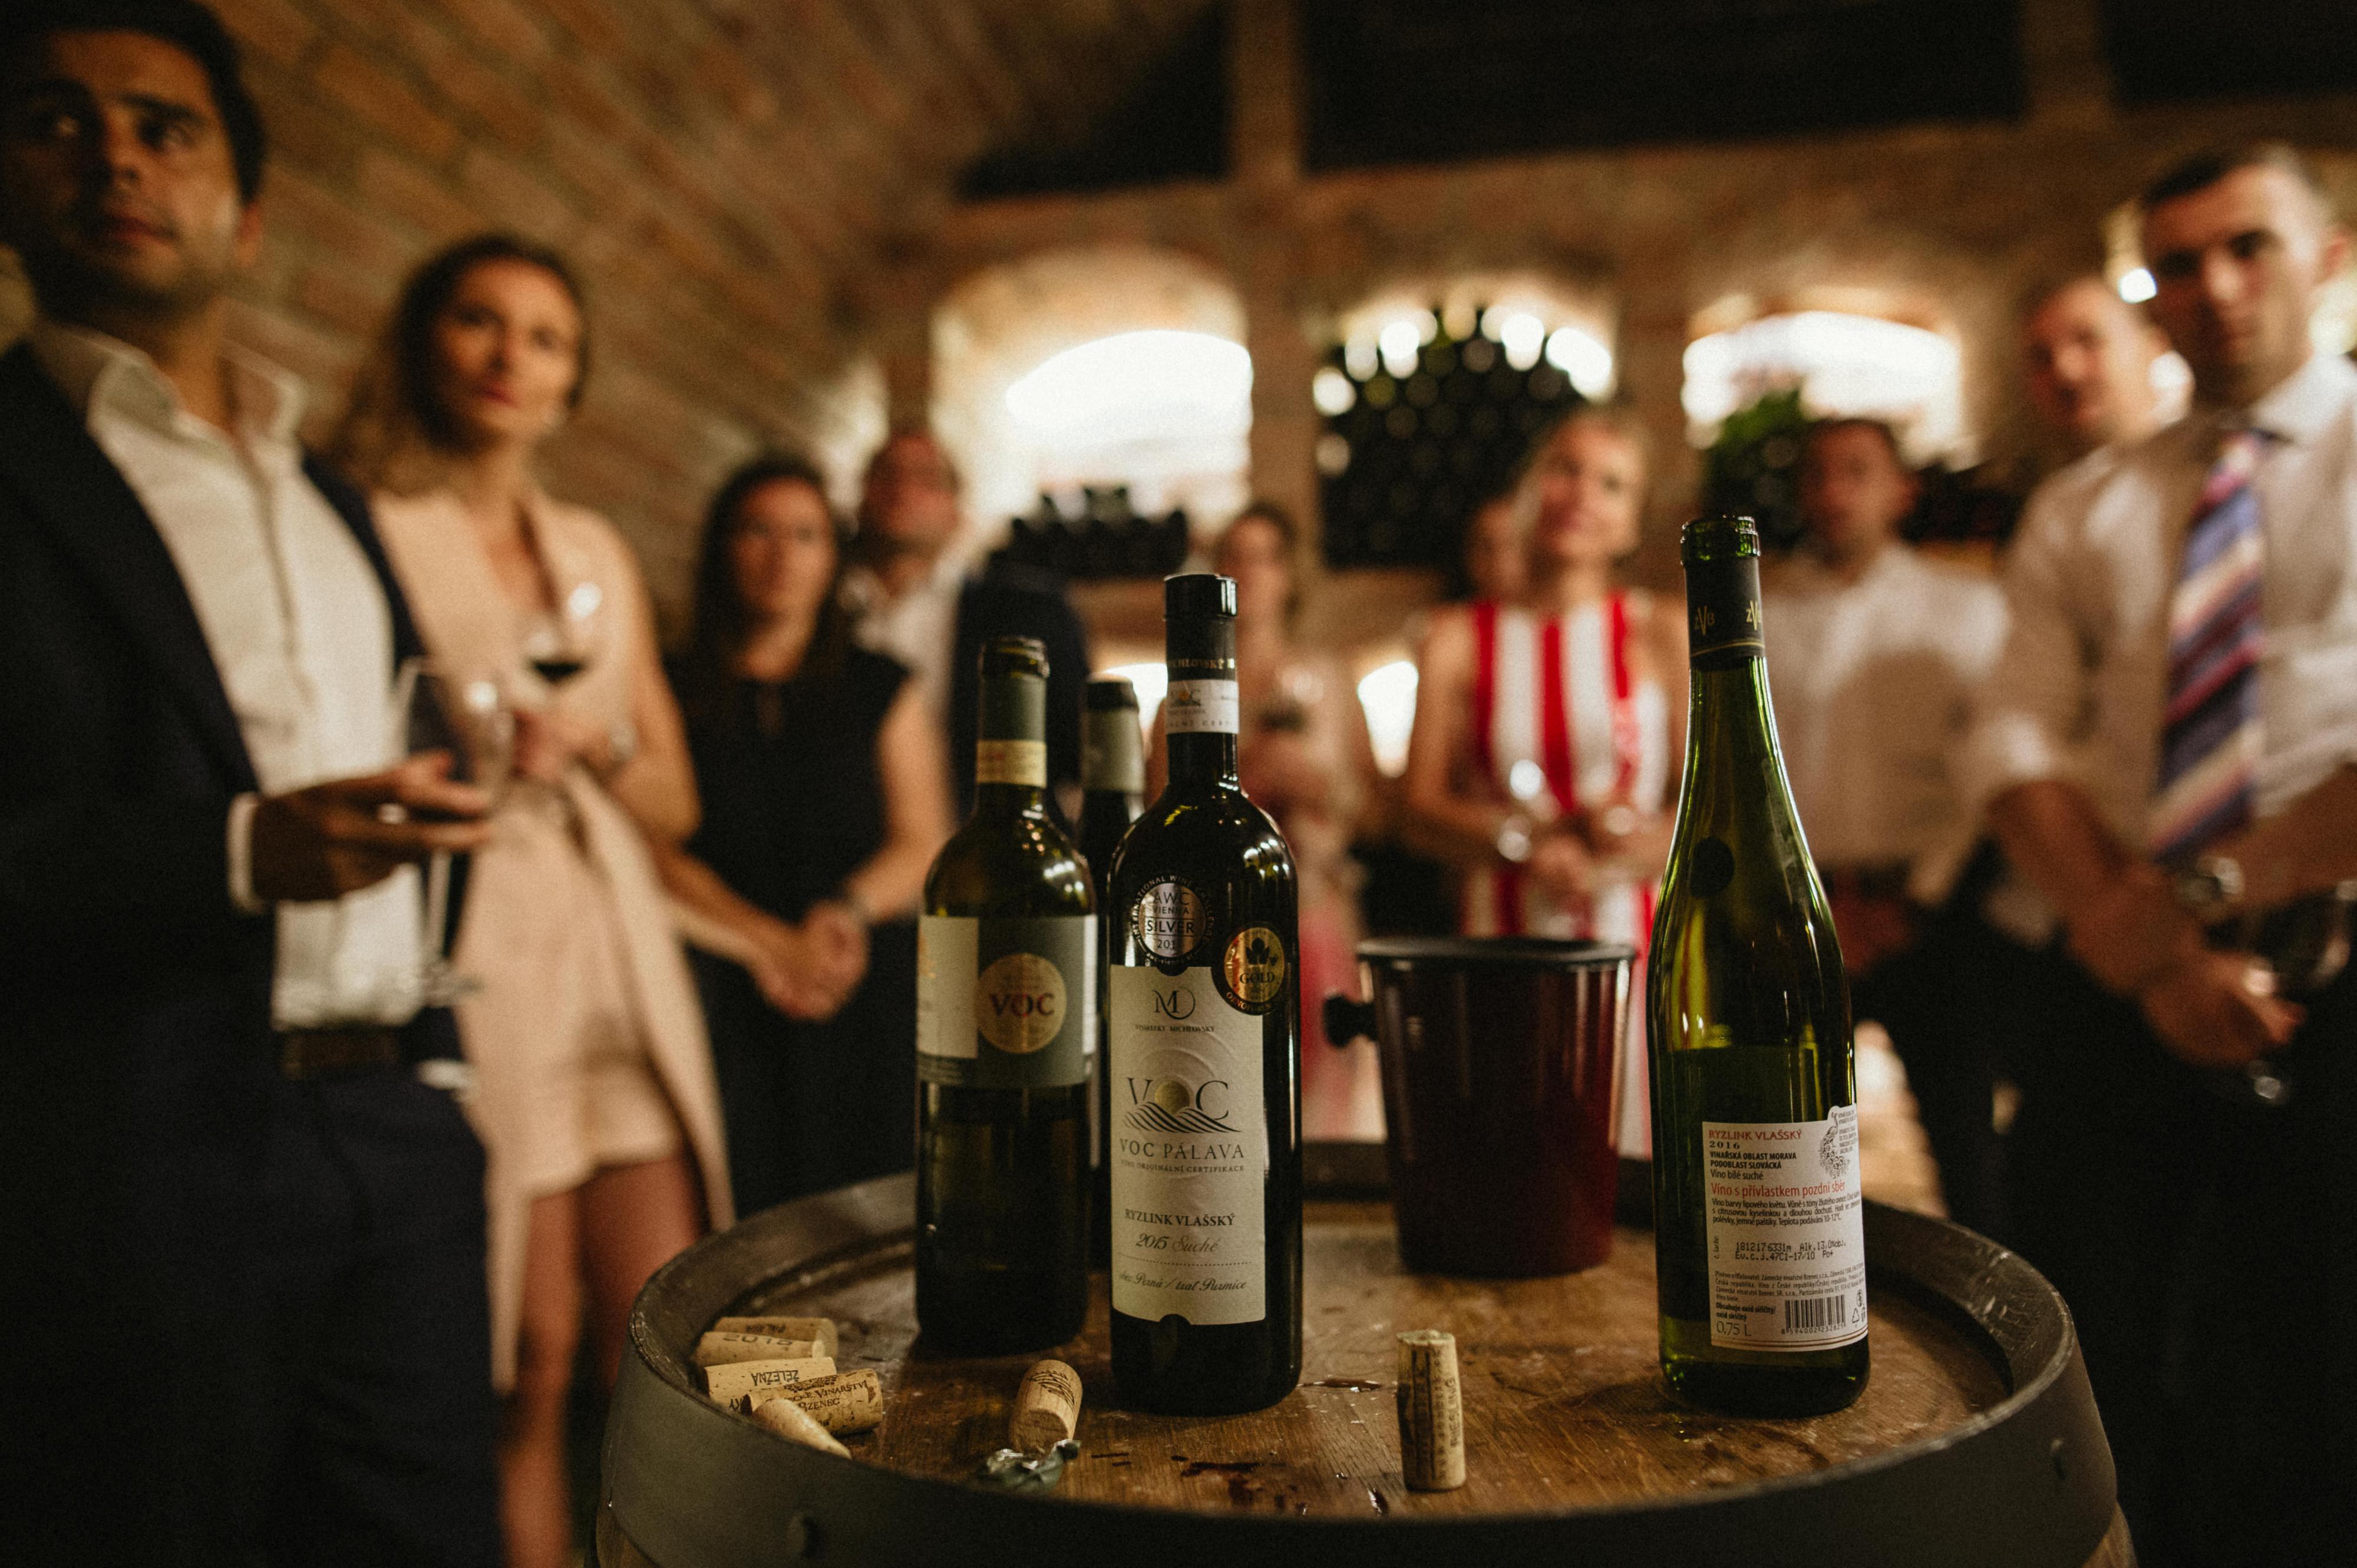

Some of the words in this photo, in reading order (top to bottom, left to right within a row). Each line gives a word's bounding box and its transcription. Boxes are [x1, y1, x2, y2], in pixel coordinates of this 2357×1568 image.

[1154, 892, 1189, 905] AWC
[1146, 920, 1194, 933] SILVER
[1240, 972, 1275, 984] GOLD
[989, 992, 1055, 1017] VOC
[1709, 1130, 1752, 1140] RYZLINK
[1755, 1128, 1802, 1140] VLAŠSKÝ
[1120, 1138, 1154, 1157] VOC
[1163, 1141, 1244, 1160] PÁLAVA
[1709, 1140, 1739, 1149] 2016
[1710, 1150, 1742, 1160] VINAŘSKÁ
[1186, 1164, 1244, 1173] CERTIFIKACE
[1710, 1160, 1747, 1169] PODOBLAST
[1711, 1168, 1726, 1179] Víno
[1742, 1171, 1764, 1180] suché
[1711, 1183, 1732, 1196] Víno
[1735, 1186, 1739, 1197] s
[1742, 1184, 1800, 1199] přívlastkem
[1802, 1181, 1830, 1199] pozdní
[1124, 1209, 1173, 1226] RYZLINK
[1175, 1213, 1235, 1226] VLAŠSKÝ
[1135, 1232, 1170, 1250] 2015
[1716, 1321, 1740, 1336] 0,75
[1744, 1324, 1752, 1336] L
